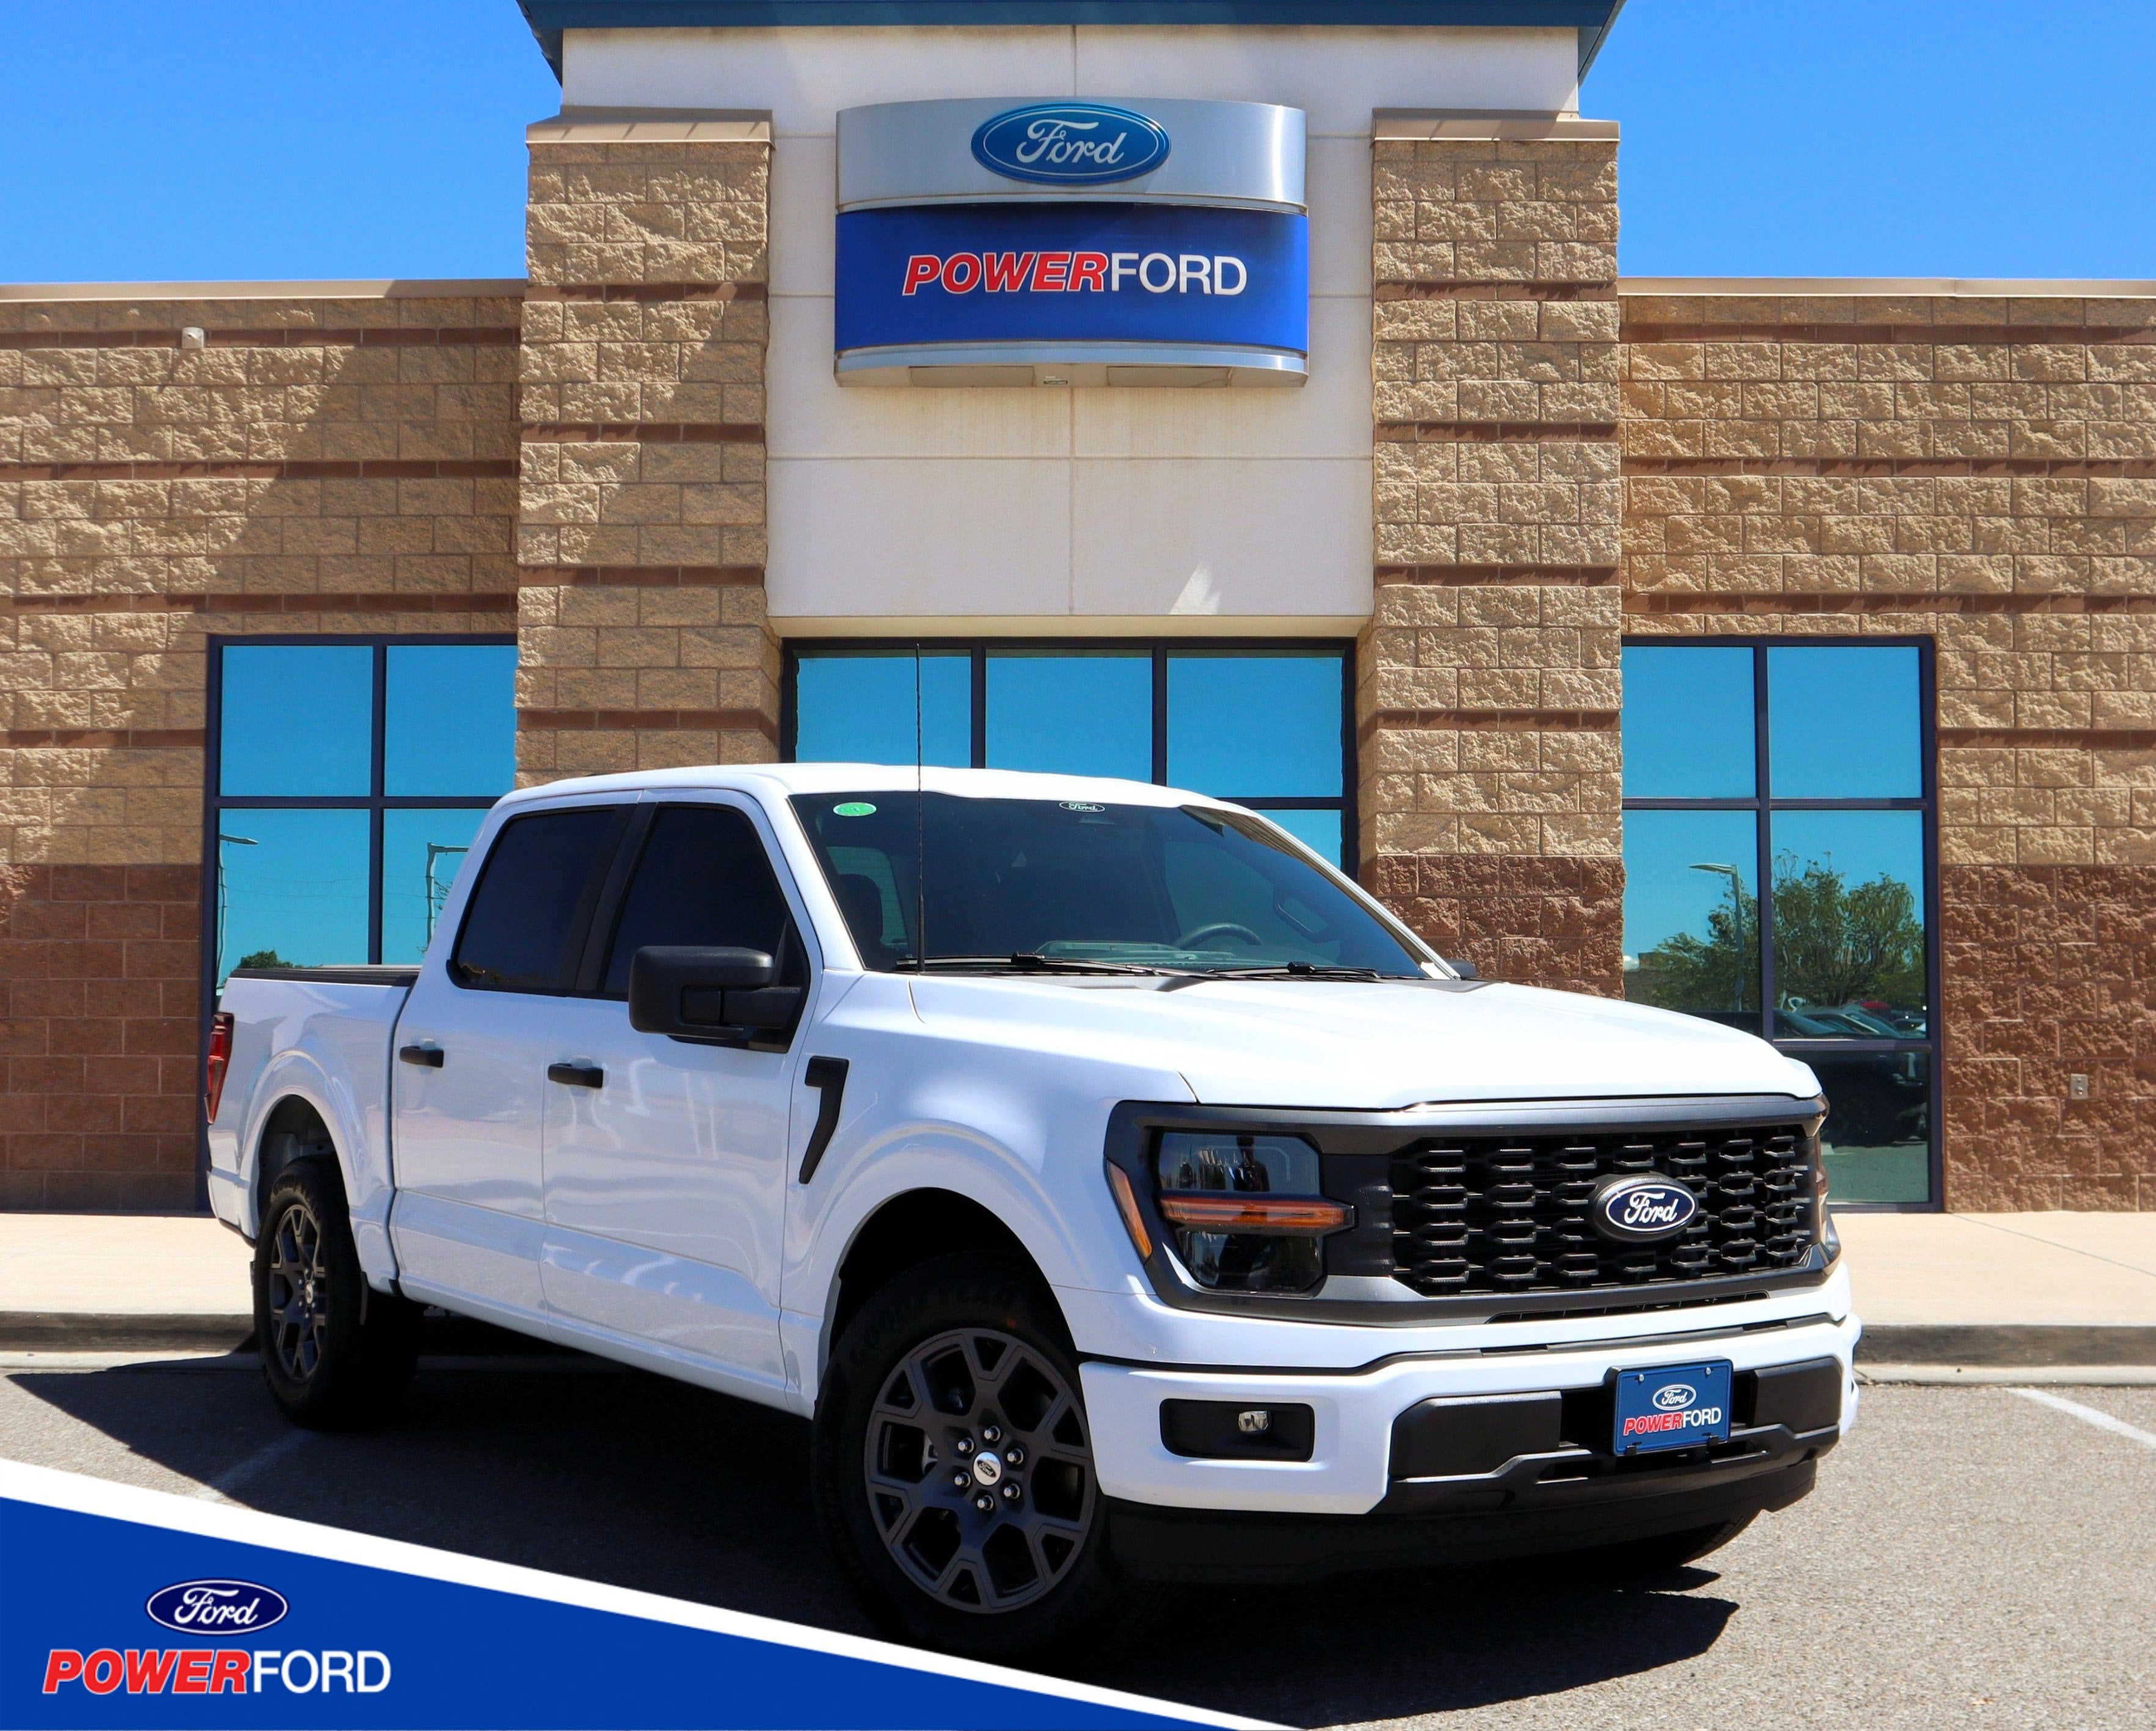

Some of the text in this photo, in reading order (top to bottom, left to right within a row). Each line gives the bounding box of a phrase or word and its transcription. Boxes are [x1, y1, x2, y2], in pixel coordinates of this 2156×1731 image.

[1016, 119, 1127, 164] Ford
[902, 251, 1248, 296] POWERFORD
[1624, 1192, 1679, 1224] Ford
[1661, 1389, 1688, 1405] Ford
[1623, 1407, 1722, 1436] POWERFORD
